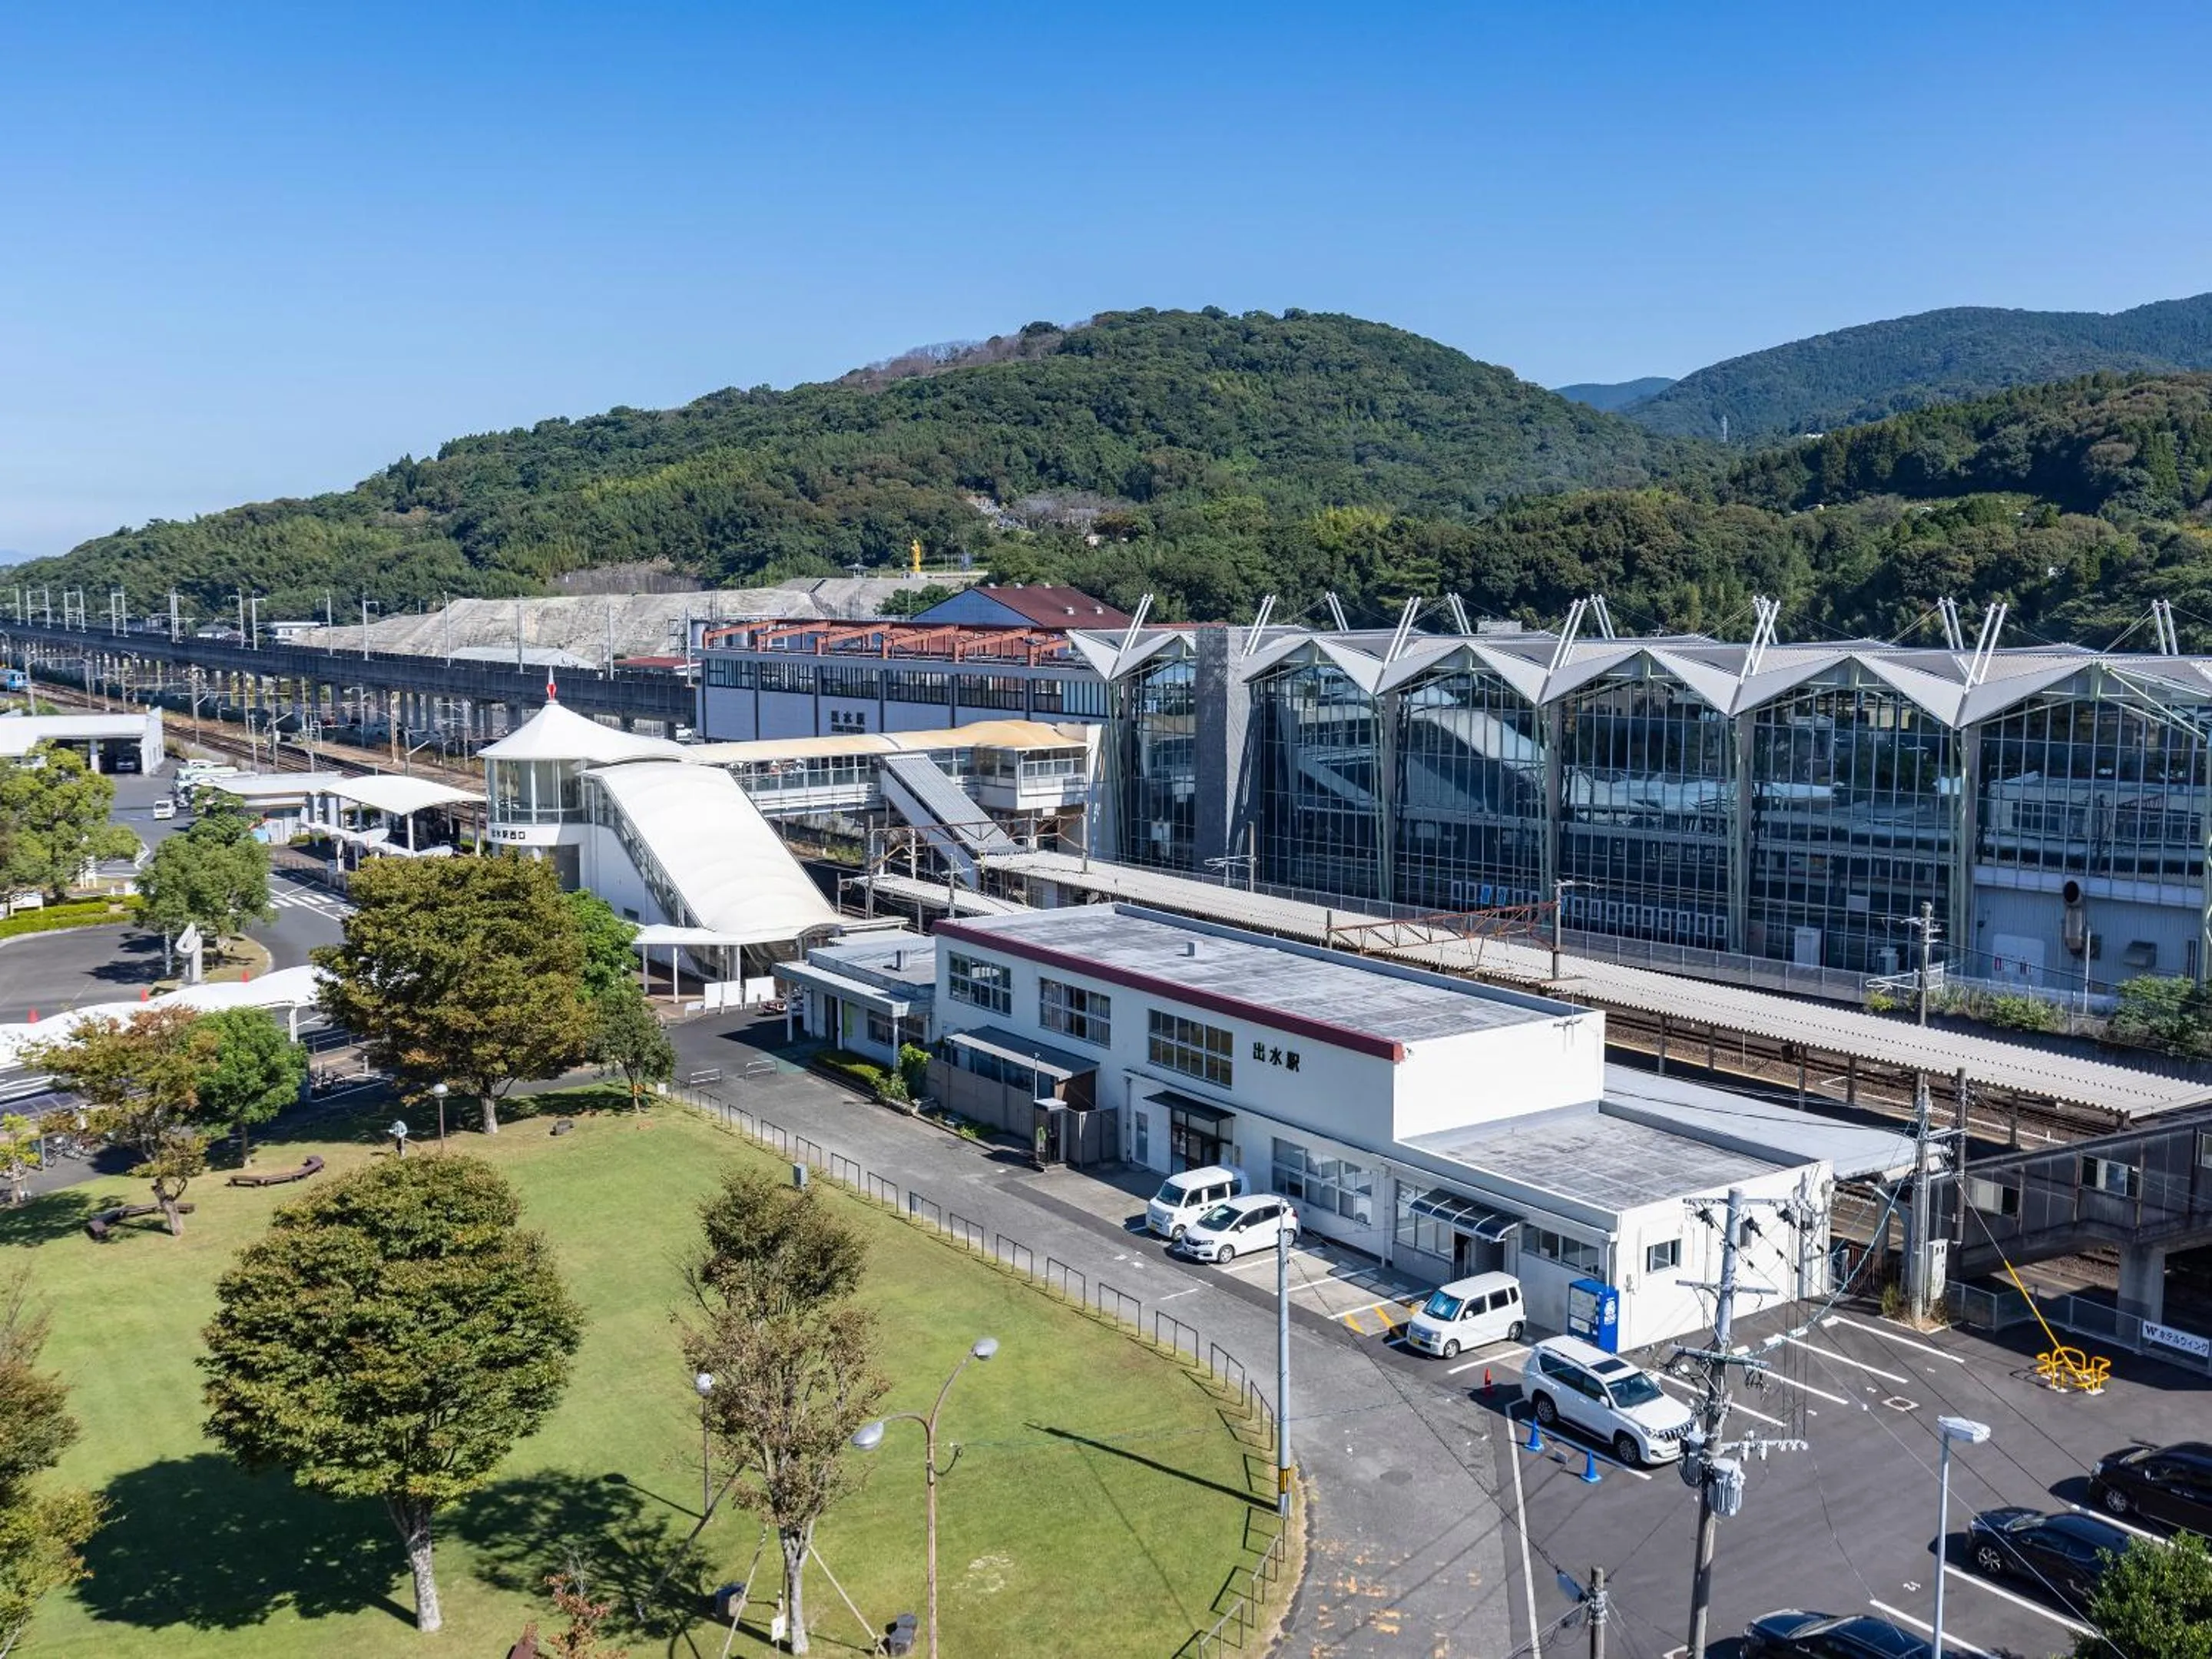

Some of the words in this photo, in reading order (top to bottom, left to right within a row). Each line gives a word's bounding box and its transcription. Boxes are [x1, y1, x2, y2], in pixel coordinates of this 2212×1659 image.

[1253, 1041, 1300, 1072] 出水駅
[2145, 1324, 2159, 1336] W
